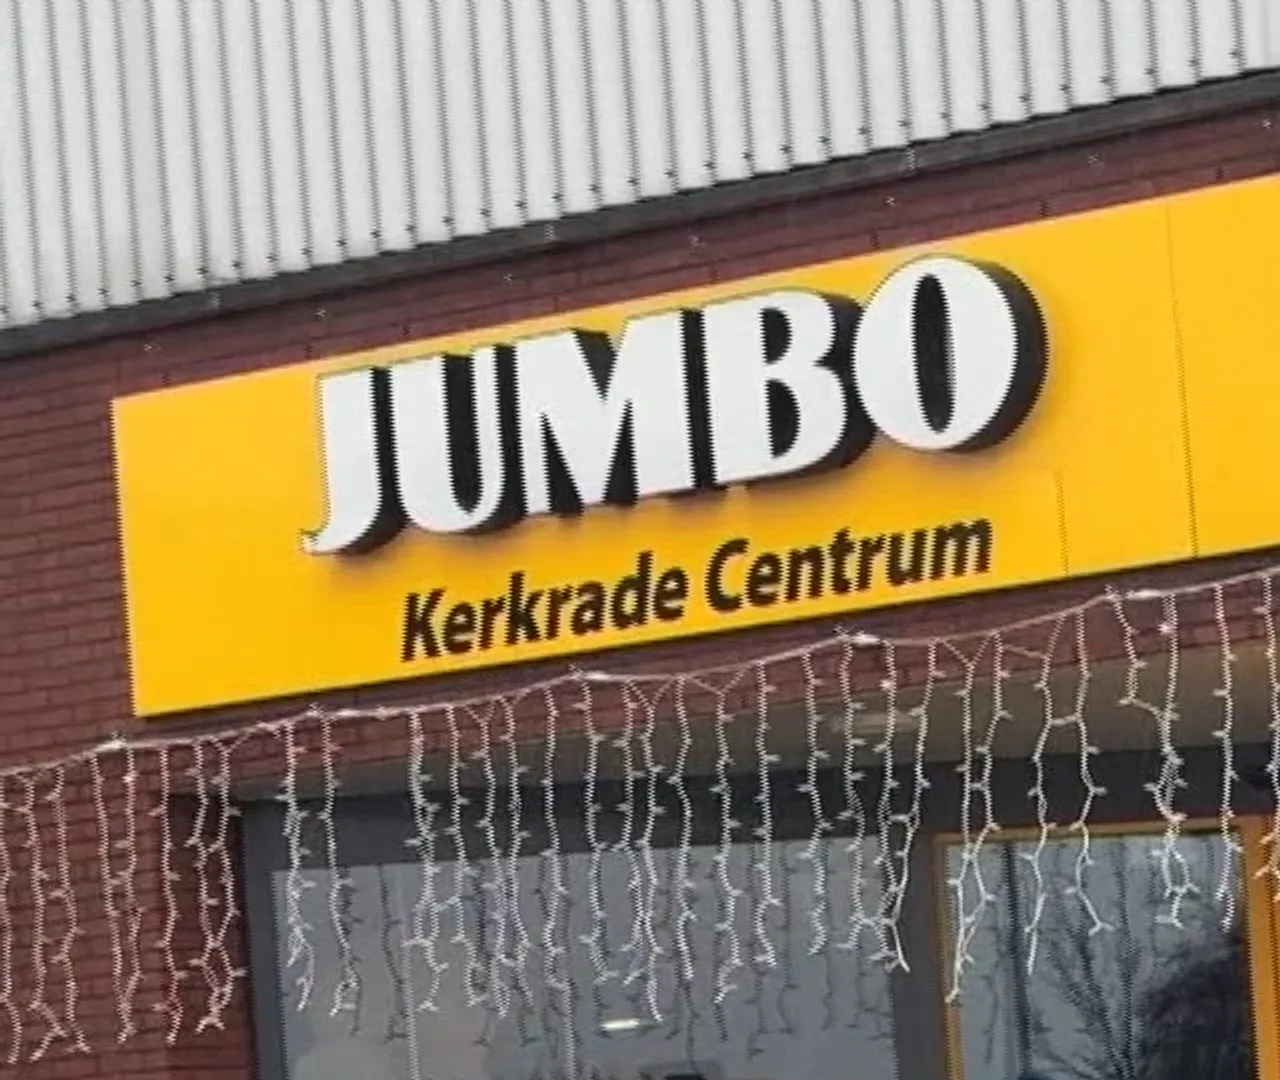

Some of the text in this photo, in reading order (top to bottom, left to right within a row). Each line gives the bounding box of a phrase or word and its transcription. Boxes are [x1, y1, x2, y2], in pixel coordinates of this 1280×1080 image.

[300, 253, 1047, 556] JUMBO
[401, 518, 993, 662] Kerkrade Centrum
